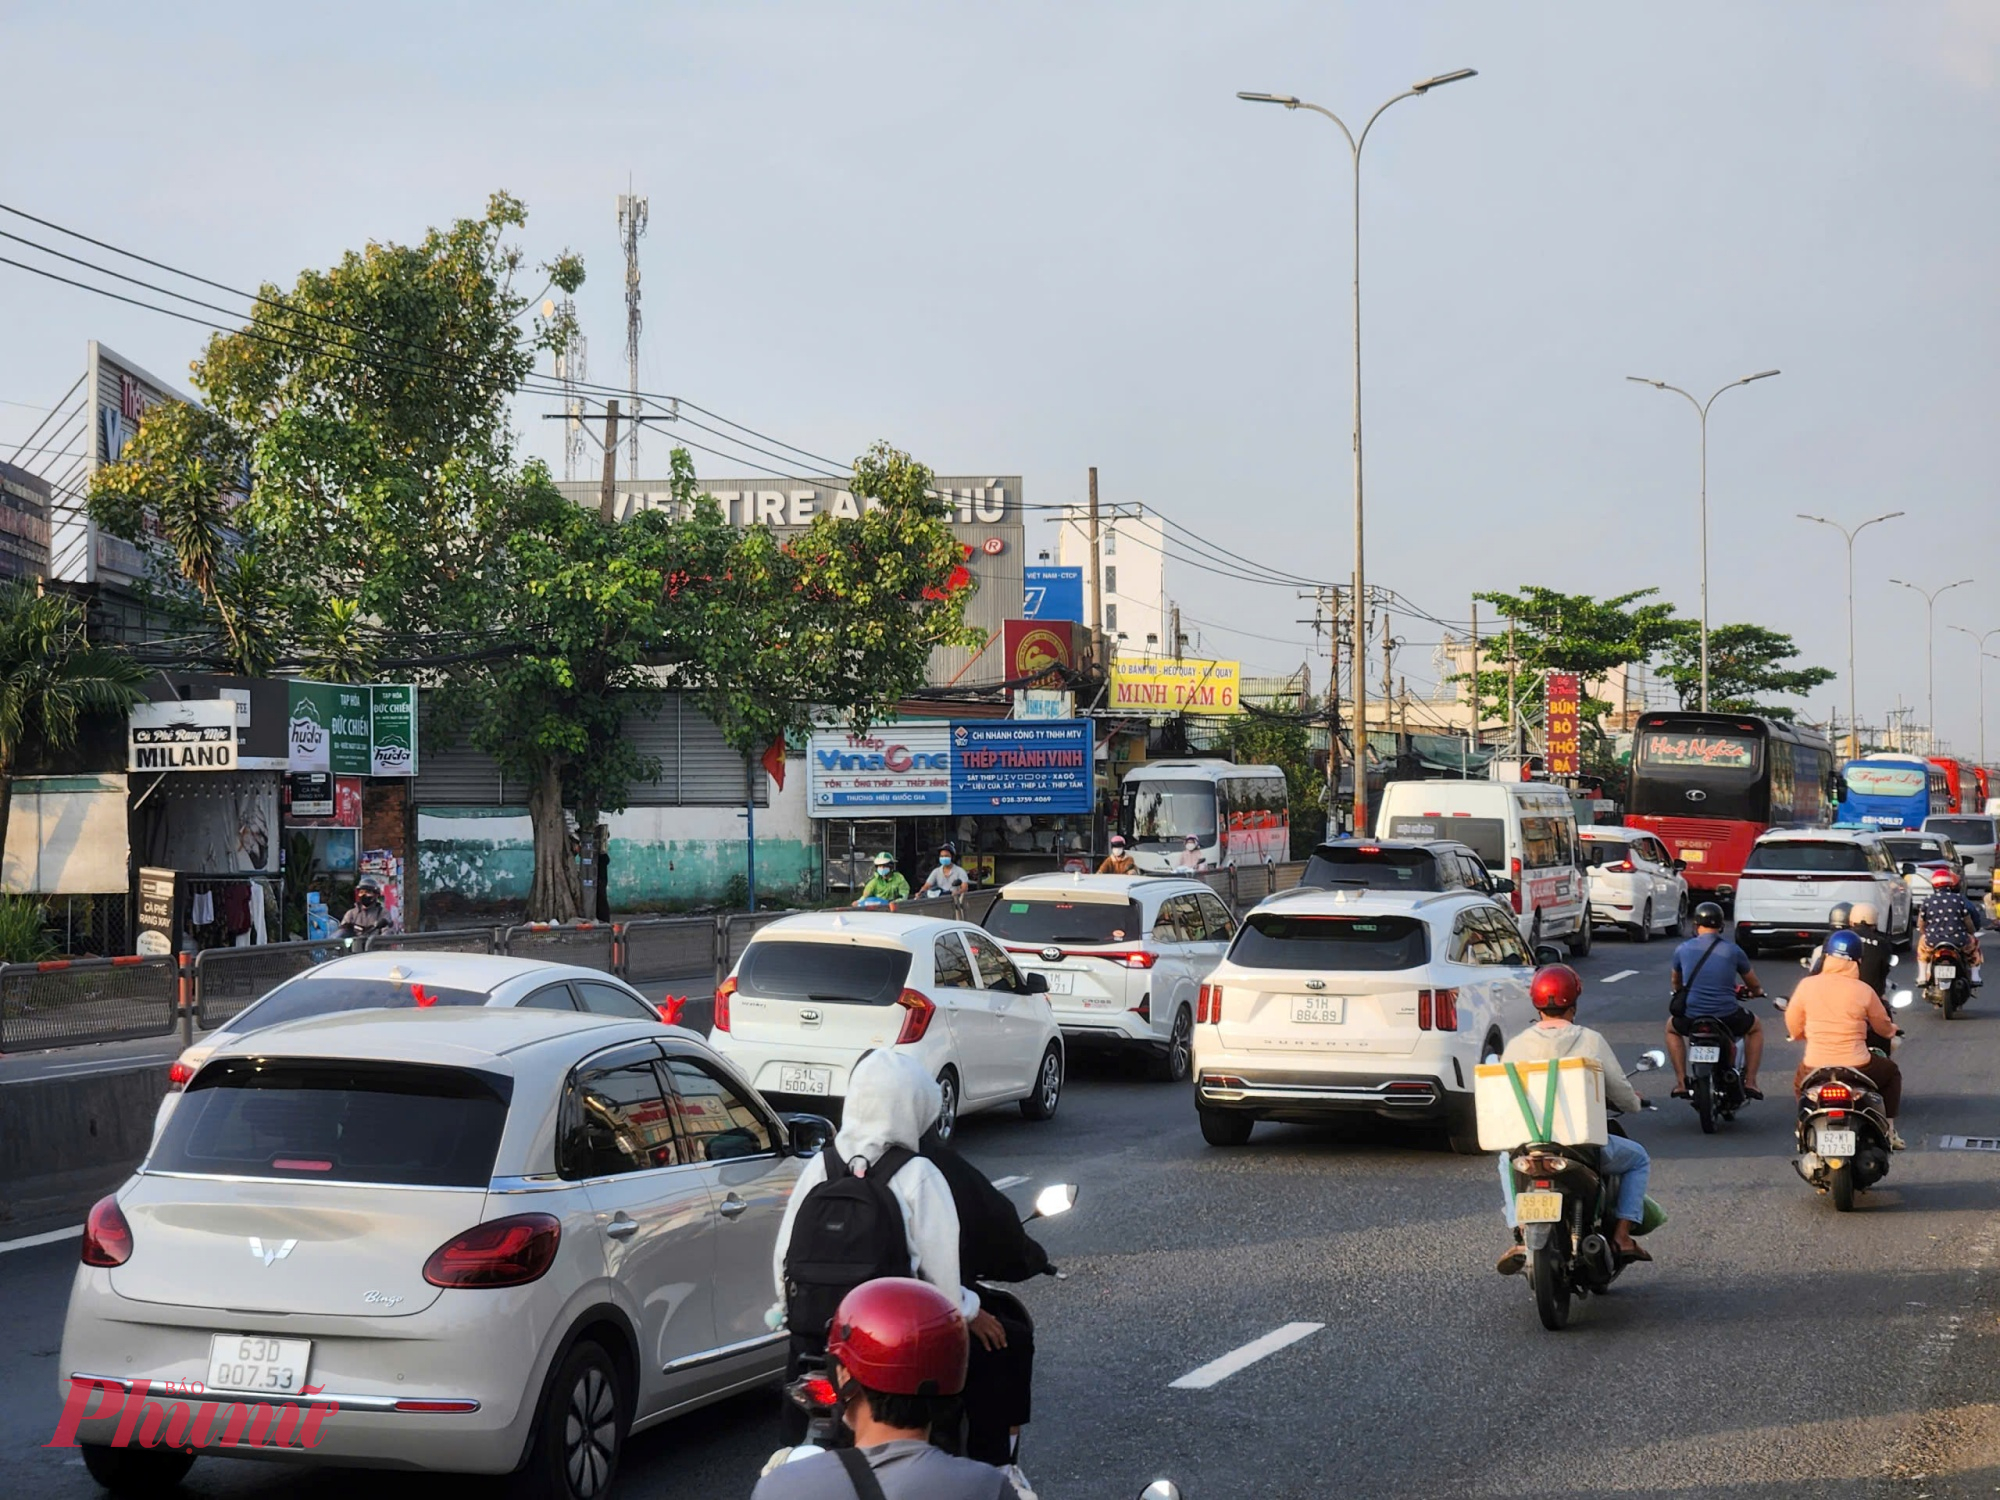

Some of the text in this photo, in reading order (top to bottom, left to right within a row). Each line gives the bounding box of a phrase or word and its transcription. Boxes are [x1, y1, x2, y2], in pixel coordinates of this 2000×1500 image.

[1215, 668, 1233, 678] QUAY
[1117, 679, 1232, 707] MINH TÂM 6
[374, 702, 388, 713] ĐỨC
[1550, 698, 1576, 714] BÚN
[331, 714, 369, 737] ĐỨC CHIẾN
[1553, 718, 1572, 734] BÒ
[846, 733, 885, 751] Thép
[972, 731, 983, 740] CHI
[1013, 729, 1035, 740] CÔNG
[1036, 730, 1045, 739] TY
[1046, 730, 1065, 739] TNHH
[1066, 730, 1082, 739] MTV
[1548, 737, 1577, 754] THỐ
[1650, 736, 1745, 763] Huệ Nghĩa
[136, 746, 230, 768] MILANO
[961, 744, 1083, 768] THÉP THÀNH VINH
[1553, 756, 1571, 772] ĐÁ
[824, 778, 842, 788] TÔN
[1306, 998, 1329, 1010] 51H
[1296, 1009, 1337, 1022] 884.89
[795, 1068, 815, 1081] 51L
[785, 1080, 824, 1093] 500.49
[363, 1289, 404, 1307] Bingo
[238, 1339, 281, 1363] 63D
[218, 1363, 294, 1390] 007.53
